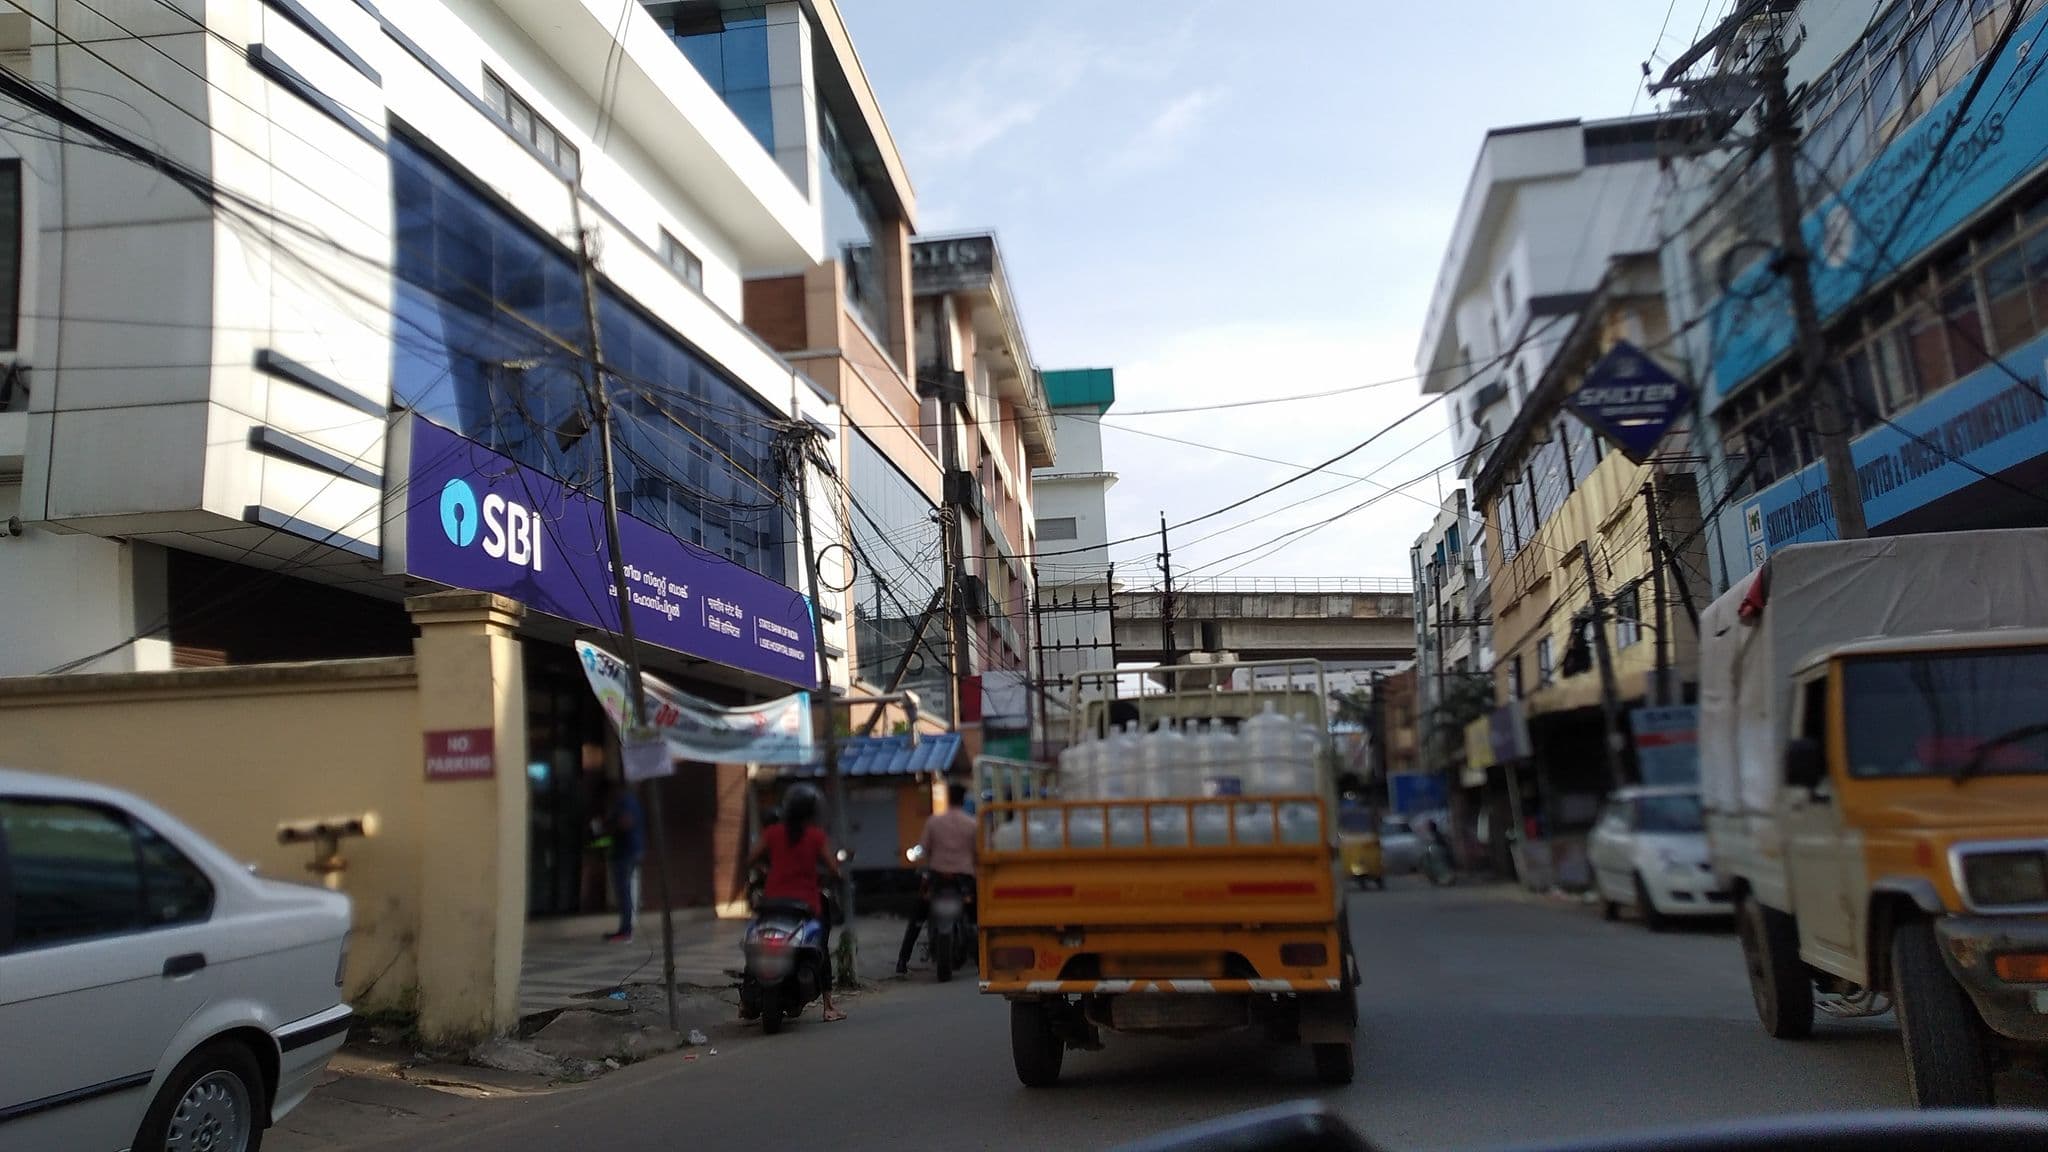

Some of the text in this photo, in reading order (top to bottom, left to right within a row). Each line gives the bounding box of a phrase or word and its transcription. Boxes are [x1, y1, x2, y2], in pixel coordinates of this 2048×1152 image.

[482, 494, 543, 572] SBI
[447, 735, 469, 752] NO
[427, 755, 491, 773] PARKING
